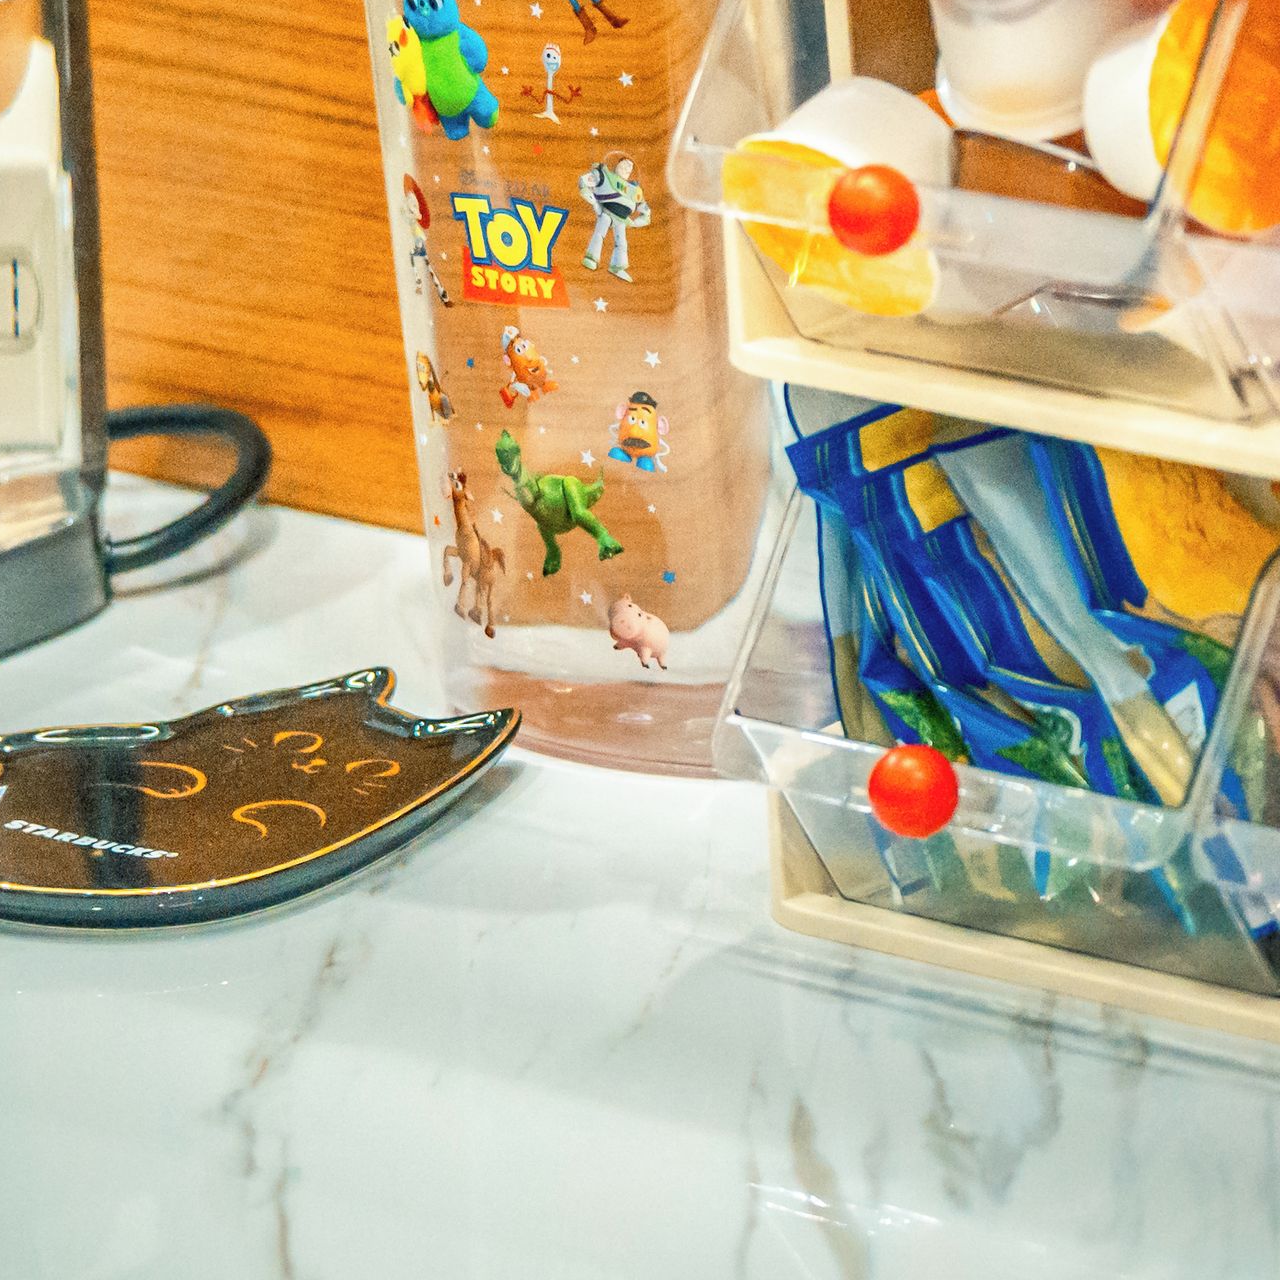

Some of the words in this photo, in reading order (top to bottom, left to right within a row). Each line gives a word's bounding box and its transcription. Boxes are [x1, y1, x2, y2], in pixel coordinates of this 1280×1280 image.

[450, 192, 568, 273] TOY
[471, 266, 555, 299] STORY
[3, 819, 169, 859] STARBUCKS
